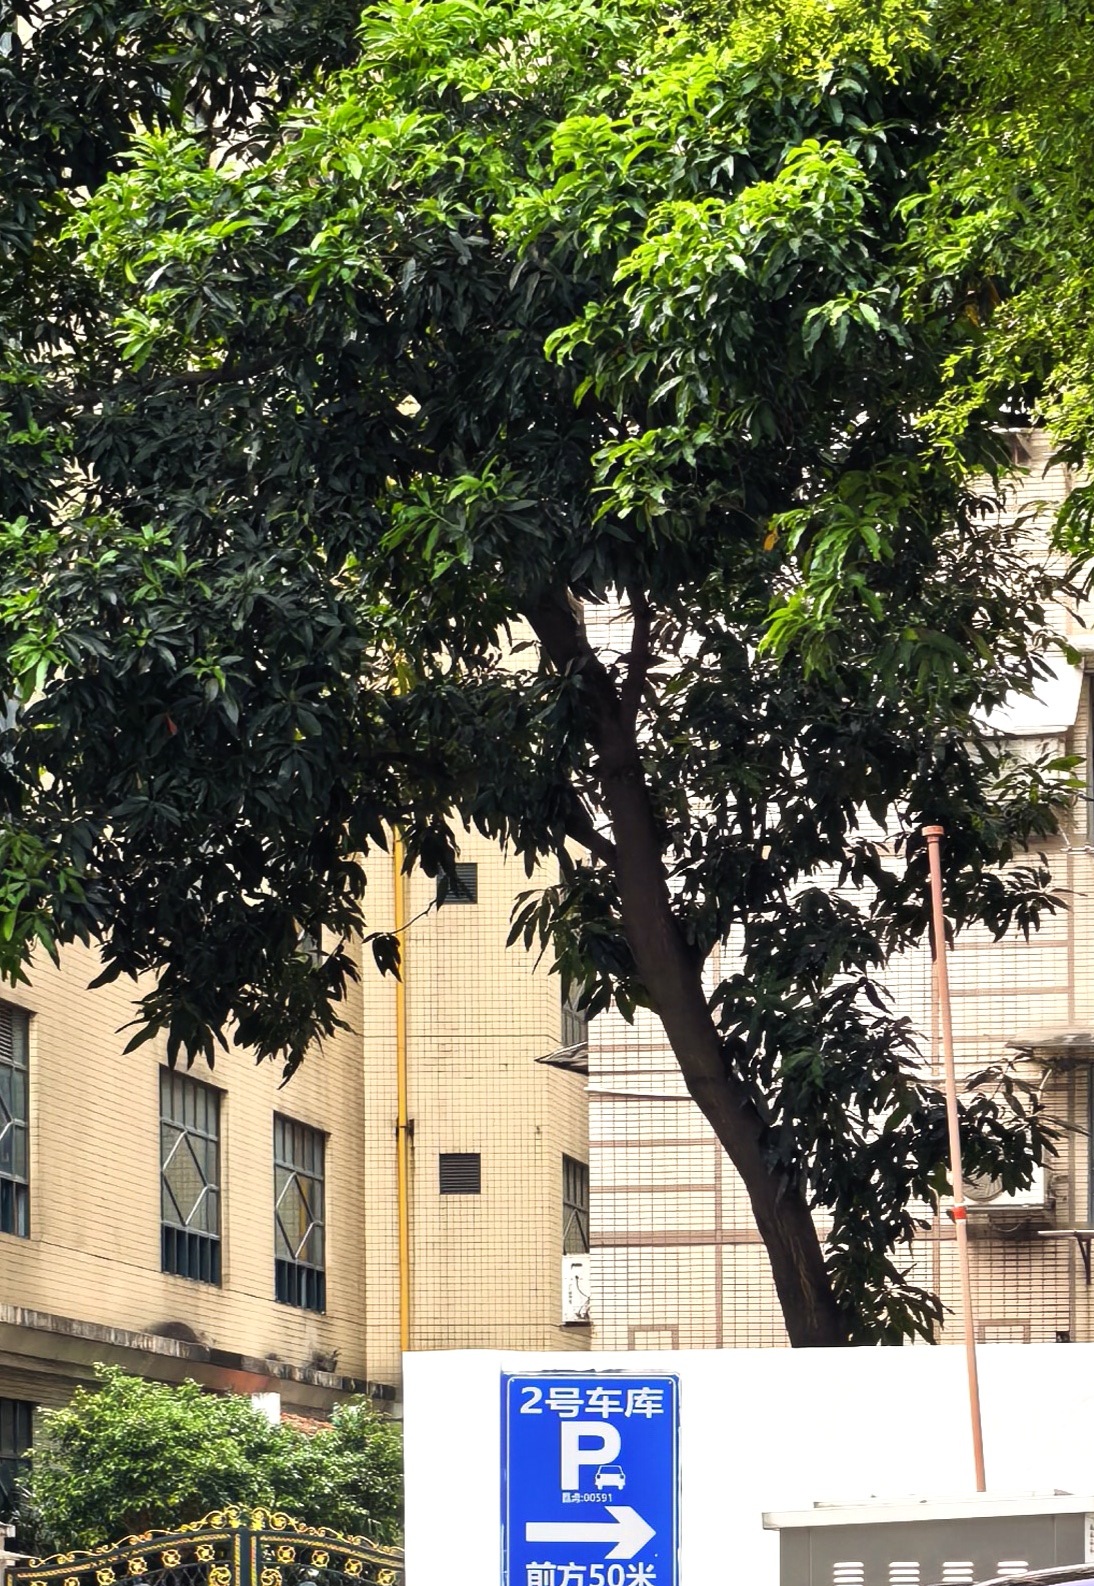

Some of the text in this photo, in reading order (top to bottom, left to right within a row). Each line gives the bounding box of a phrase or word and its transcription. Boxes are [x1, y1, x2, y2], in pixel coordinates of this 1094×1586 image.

[520, 1387, 663, 1418] 2号车库
[561, 1421, 621, 1490] P
